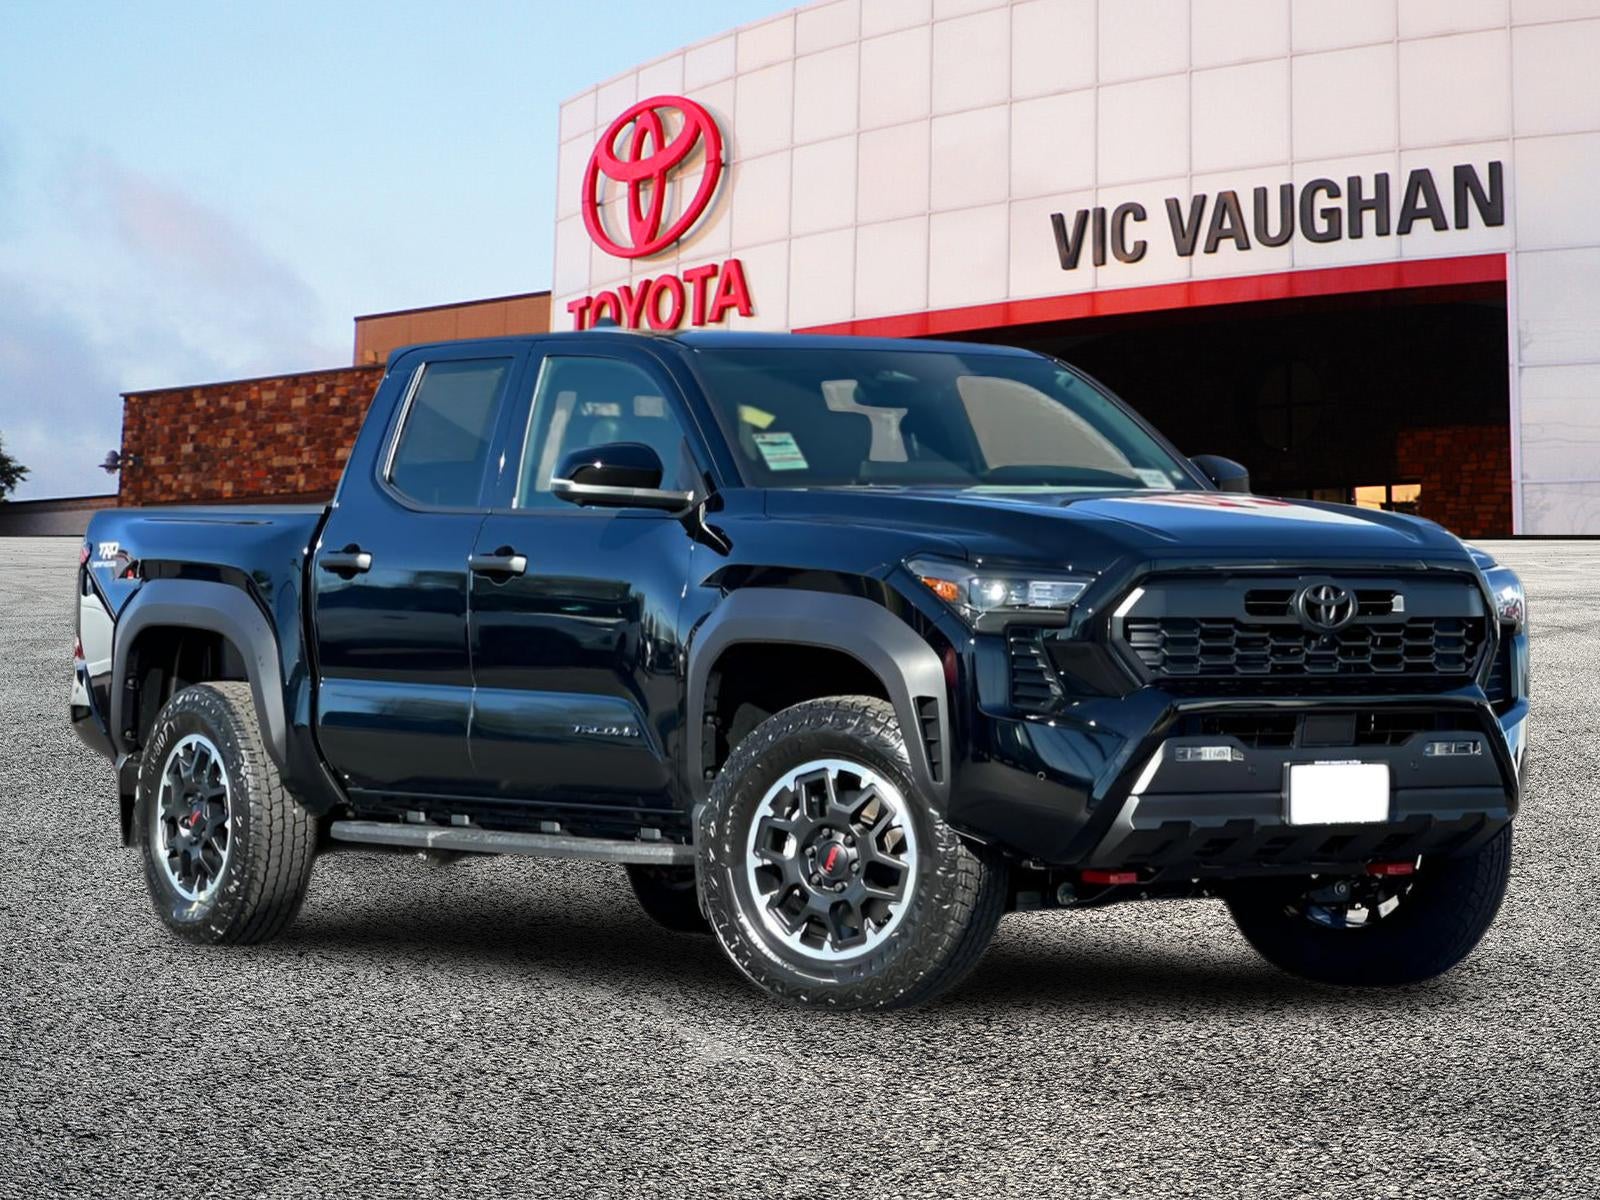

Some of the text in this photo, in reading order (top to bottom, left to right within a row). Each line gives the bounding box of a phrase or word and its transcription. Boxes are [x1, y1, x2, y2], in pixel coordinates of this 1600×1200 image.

[1050, 161, 1505, 270] VIC VAUGHAN
[567, 258, 754, 331] TOYOTA
